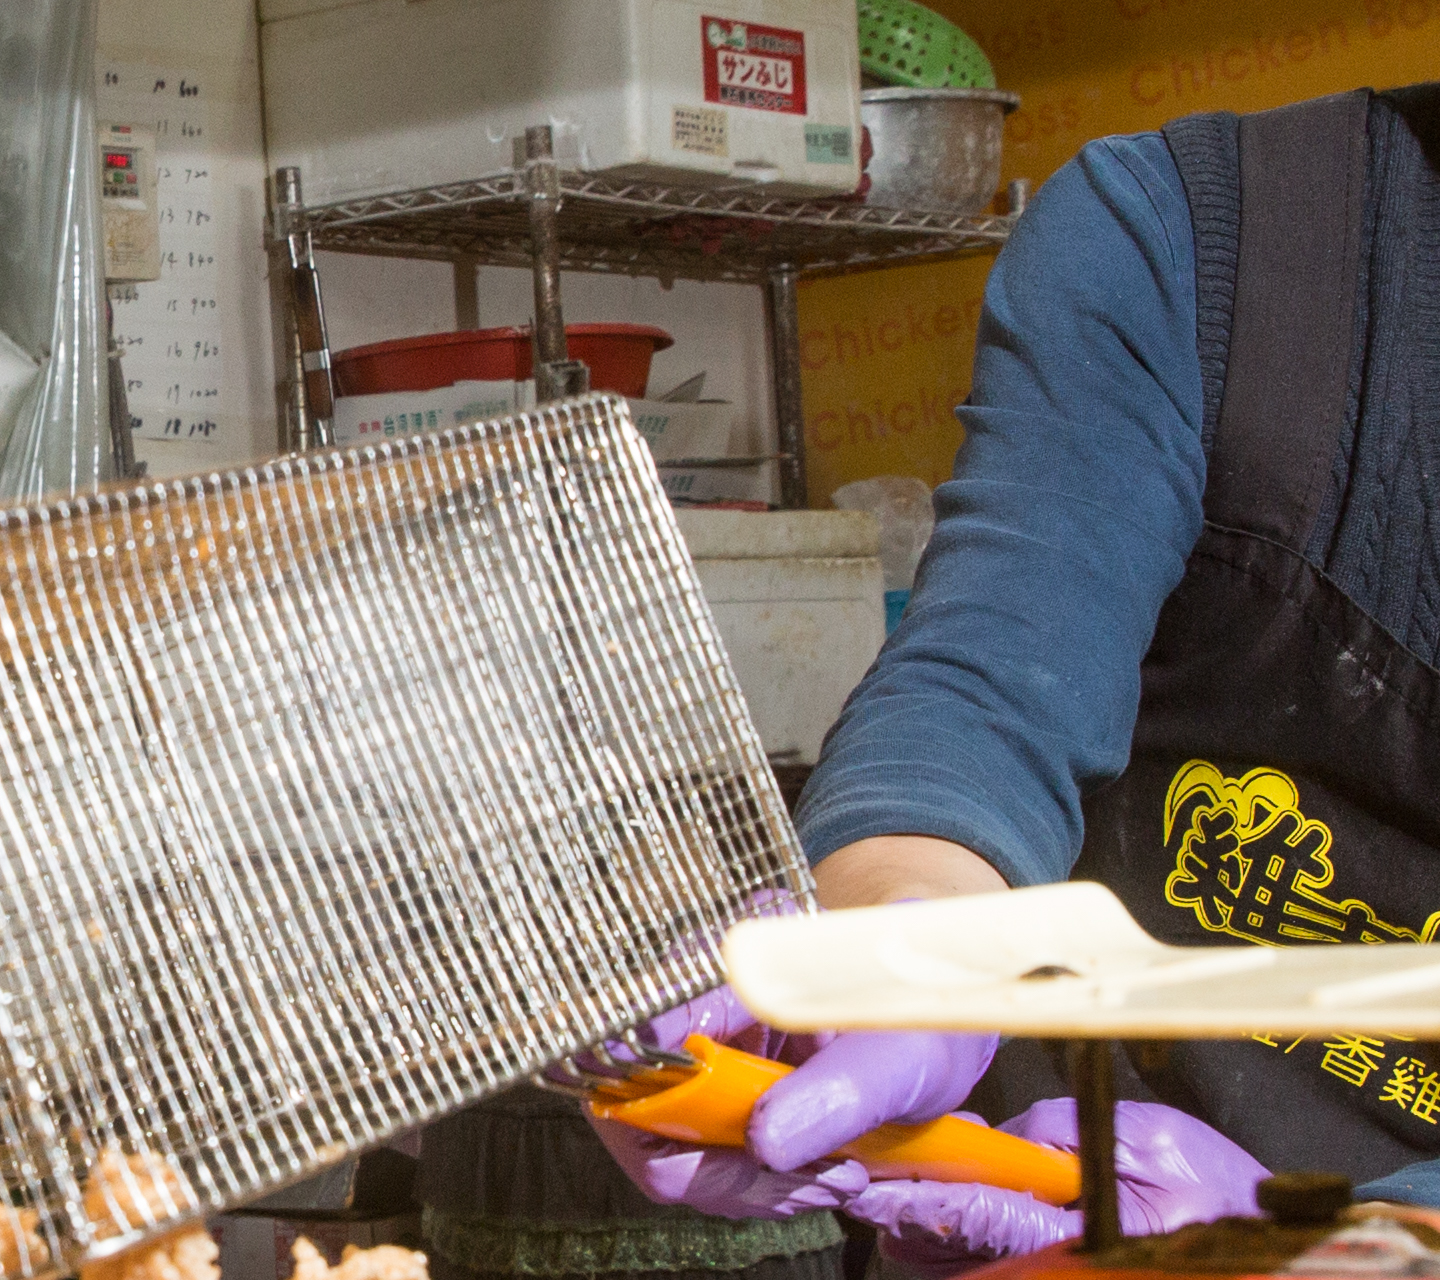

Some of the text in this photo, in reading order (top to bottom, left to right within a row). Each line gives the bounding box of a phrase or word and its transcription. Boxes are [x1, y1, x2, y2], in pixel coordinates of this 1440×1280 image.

[1128, 17, 1349, 107] Chicken
[179, 80, 200, 98] 600
[191, 297, 217, 316] 900
[166, 340, 220, 362] 16 960
[164, 418, 182, 435] 18
